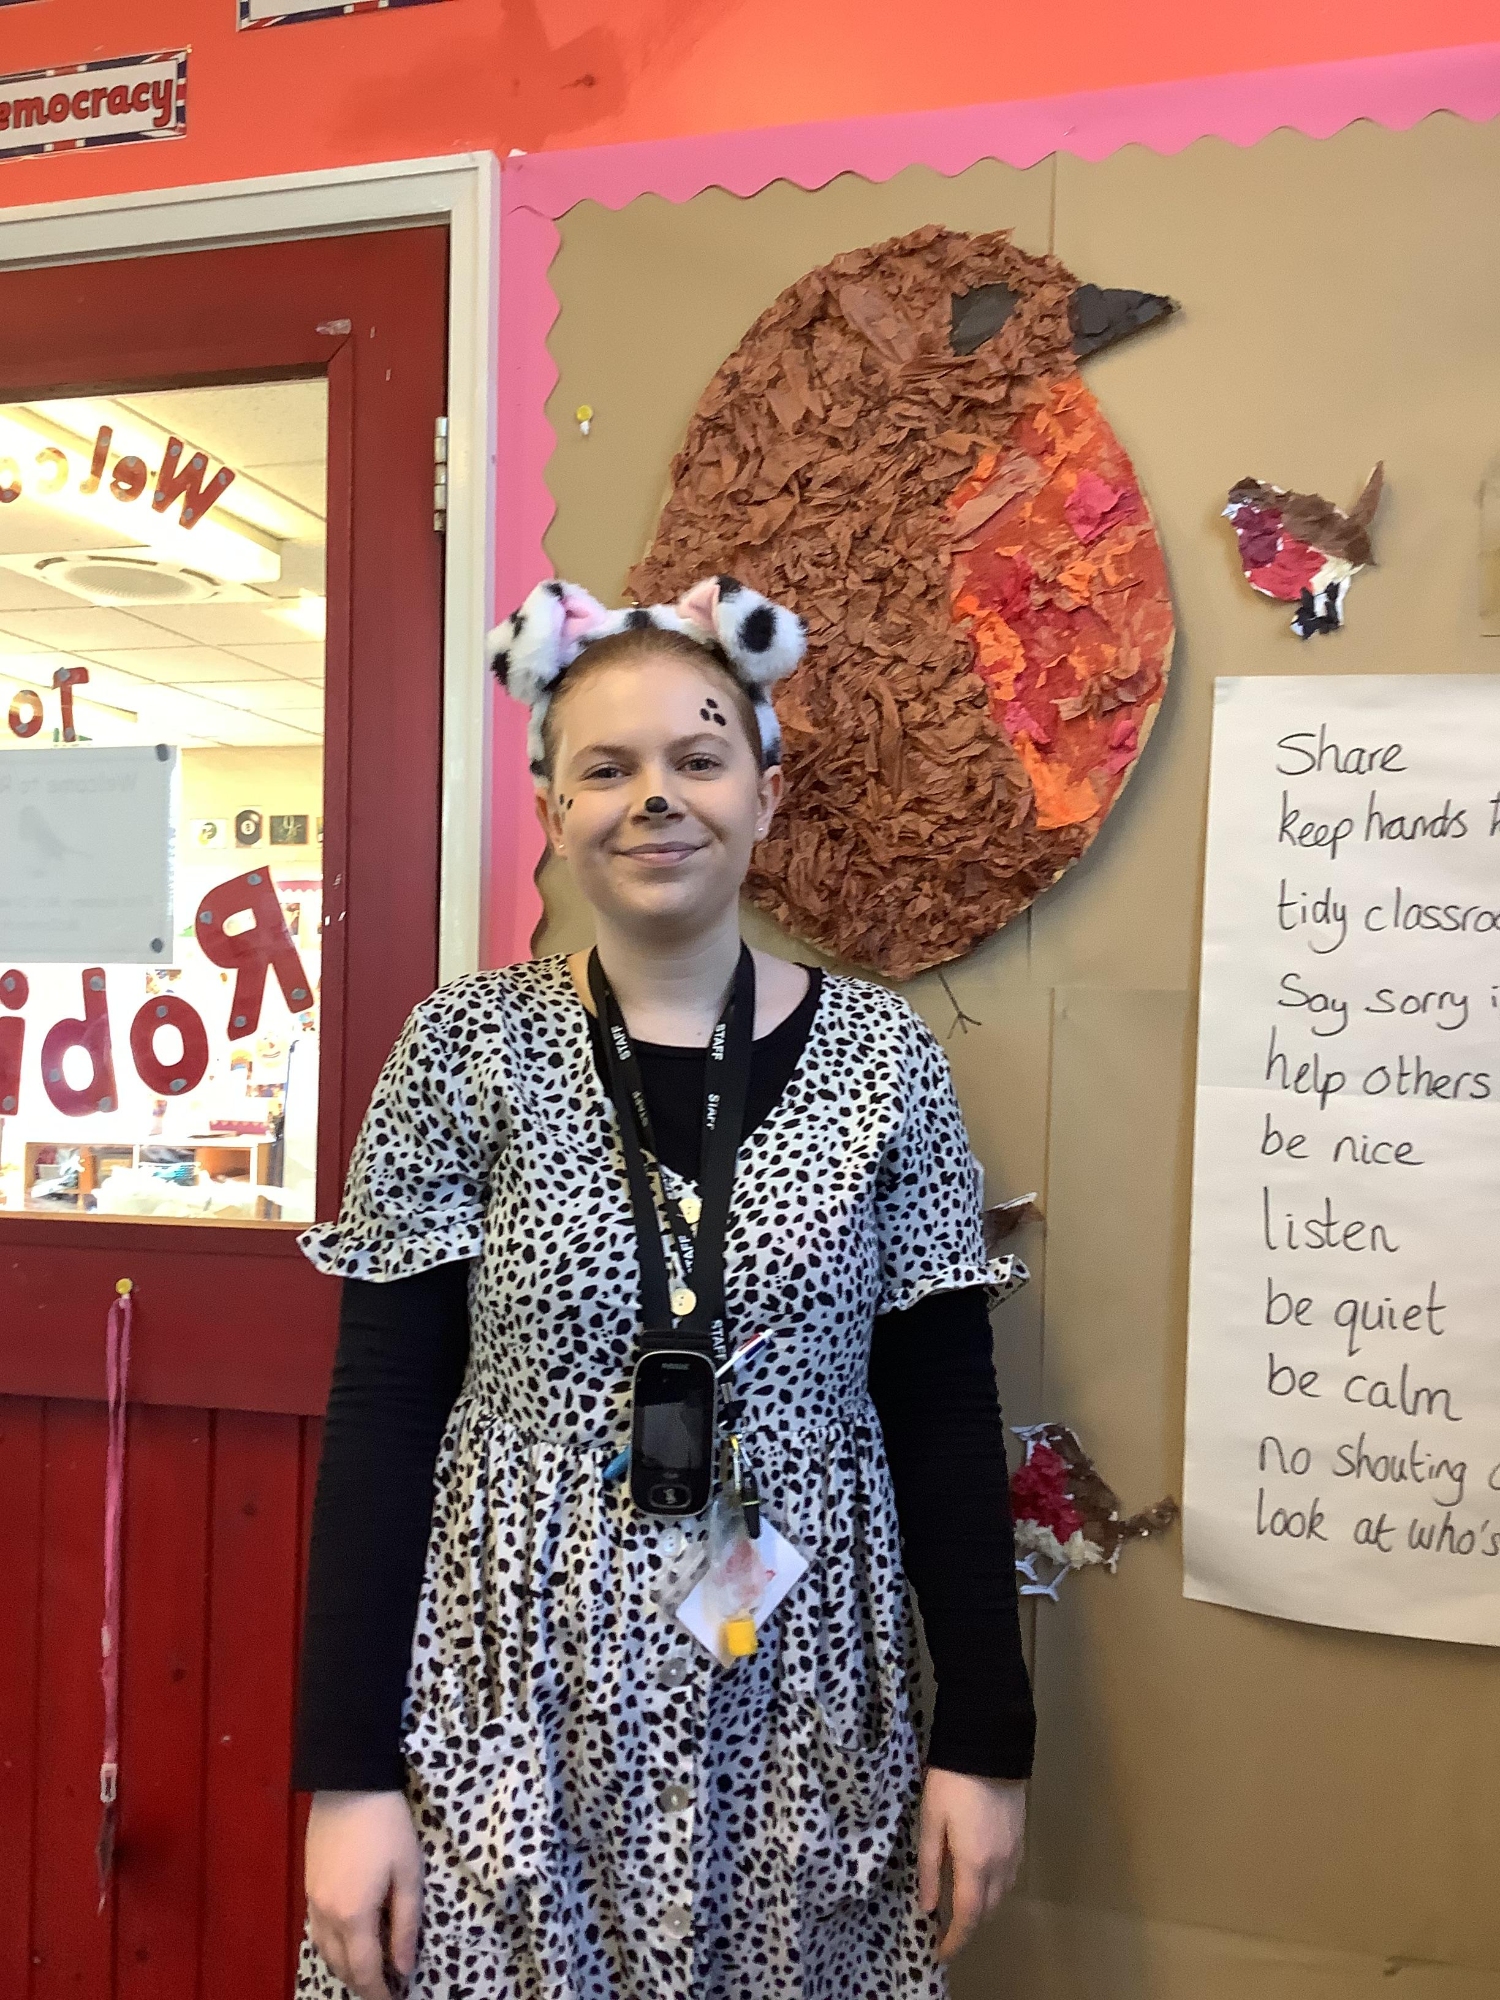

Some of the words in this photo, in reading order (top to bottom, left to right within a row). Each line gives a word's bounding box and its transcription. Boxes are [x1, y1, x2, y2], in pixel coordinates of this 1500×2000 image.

[1276, 723, 1408, 776] Share
[1278, 790, 1354, 860] keep
[1365, 790, 1469, 842] hands
[1277, 878, 1348, 954] tidy
[610, 1025, 632, 1061] STAFF
[711, 1023, 727, 1061] STAFF
[1364, 988, 1470, 1031] sorry
[1265, 1026, 1346, 1110] help
[1362, 1055, 1491, 1099] others
[1261, 1113, 1309, 1159] be
[1333, 1135, 1425, 1166] nice
[1263, 1186, 1400, 1252] listen
[677, 1235, 695, 1274] TAFF
[1265, 1277, 1313, 1327] be
[1334, 1281, 1448, 1357] quiet
[1268, 1352, 1321, 1398] be
[1344, 1363, 1463, 1421] calm
[1332, 1432, 1467, 1507] shouting
[1256, 1487, 1328, 1541] look
[1354, 1513, 1397, 1553] at
[1408, 1511, 1500, 1557] who's
